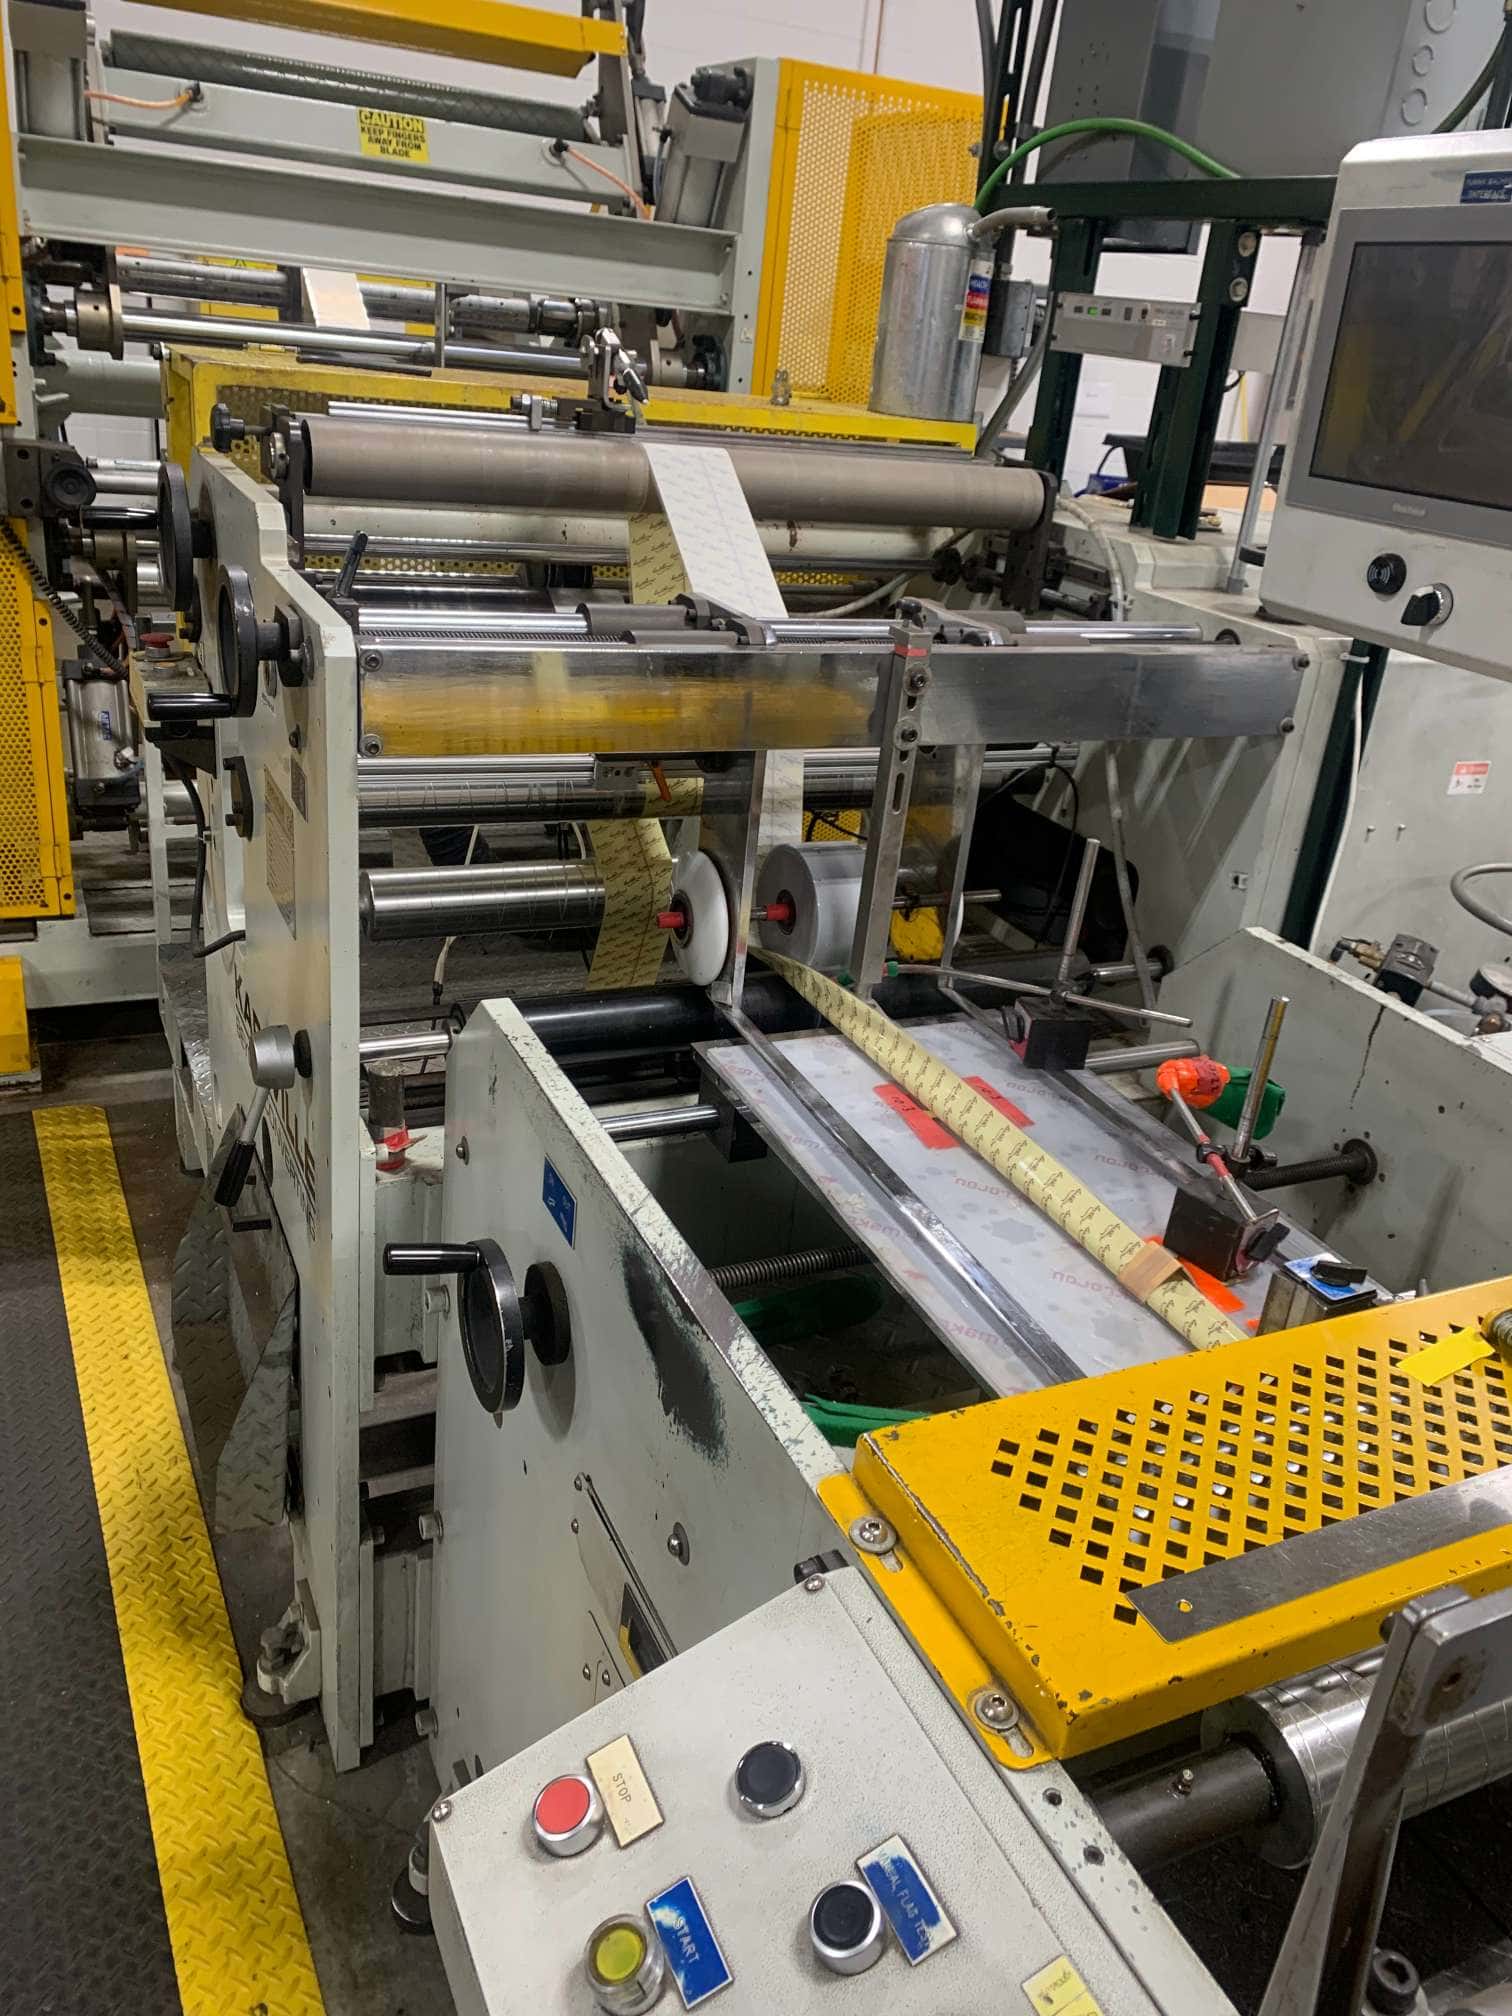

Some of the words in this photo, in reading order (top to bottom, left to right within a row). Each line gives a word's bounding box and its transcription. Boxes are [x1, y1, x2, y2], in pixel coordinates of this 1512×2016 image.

[359, 109, 425, 134] CAUTION
[361, 126, 385, 138] KEEP
[386, 130, 426, 143] FINGERS
[368, 136, 392, 147] AWAY
[395, 140, 422, 152] FROM
[380, 145, 410, 158] BLADE
[612, 1772, 632, 1802] STOP
[672, 1915, 700, 1964] START
